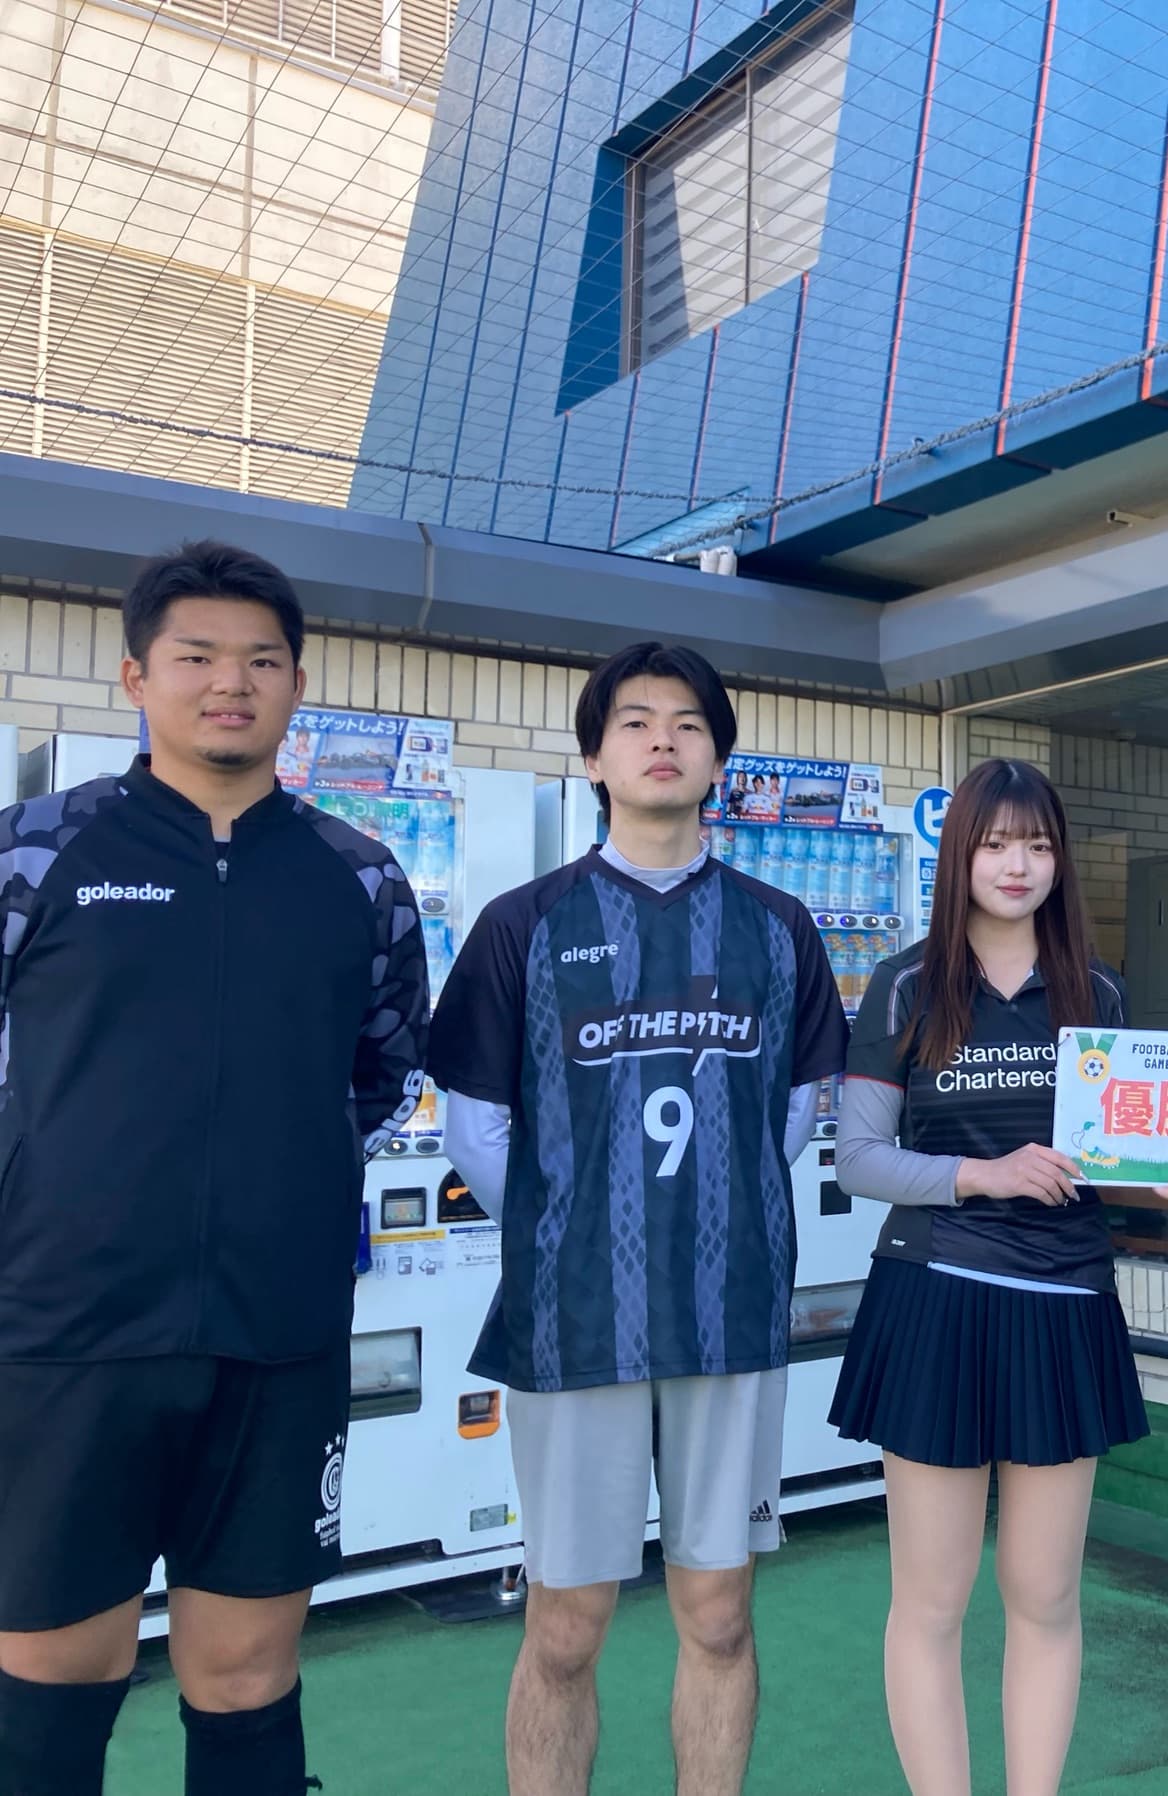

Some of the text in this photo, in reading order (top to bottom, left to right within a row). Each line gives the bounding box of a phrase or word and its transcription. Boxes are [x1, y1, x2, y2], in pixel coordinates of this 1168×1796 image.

[77, 881, 175, 906] goleador
[560, 943, 619, 964] alegre
[629, 1011, 678, 1038] THE
[950, 1042, 1057, 1065] Standard
[935, 1066, 1057, 1093] Chartered
[643, 1086, 694, 1177] 9
